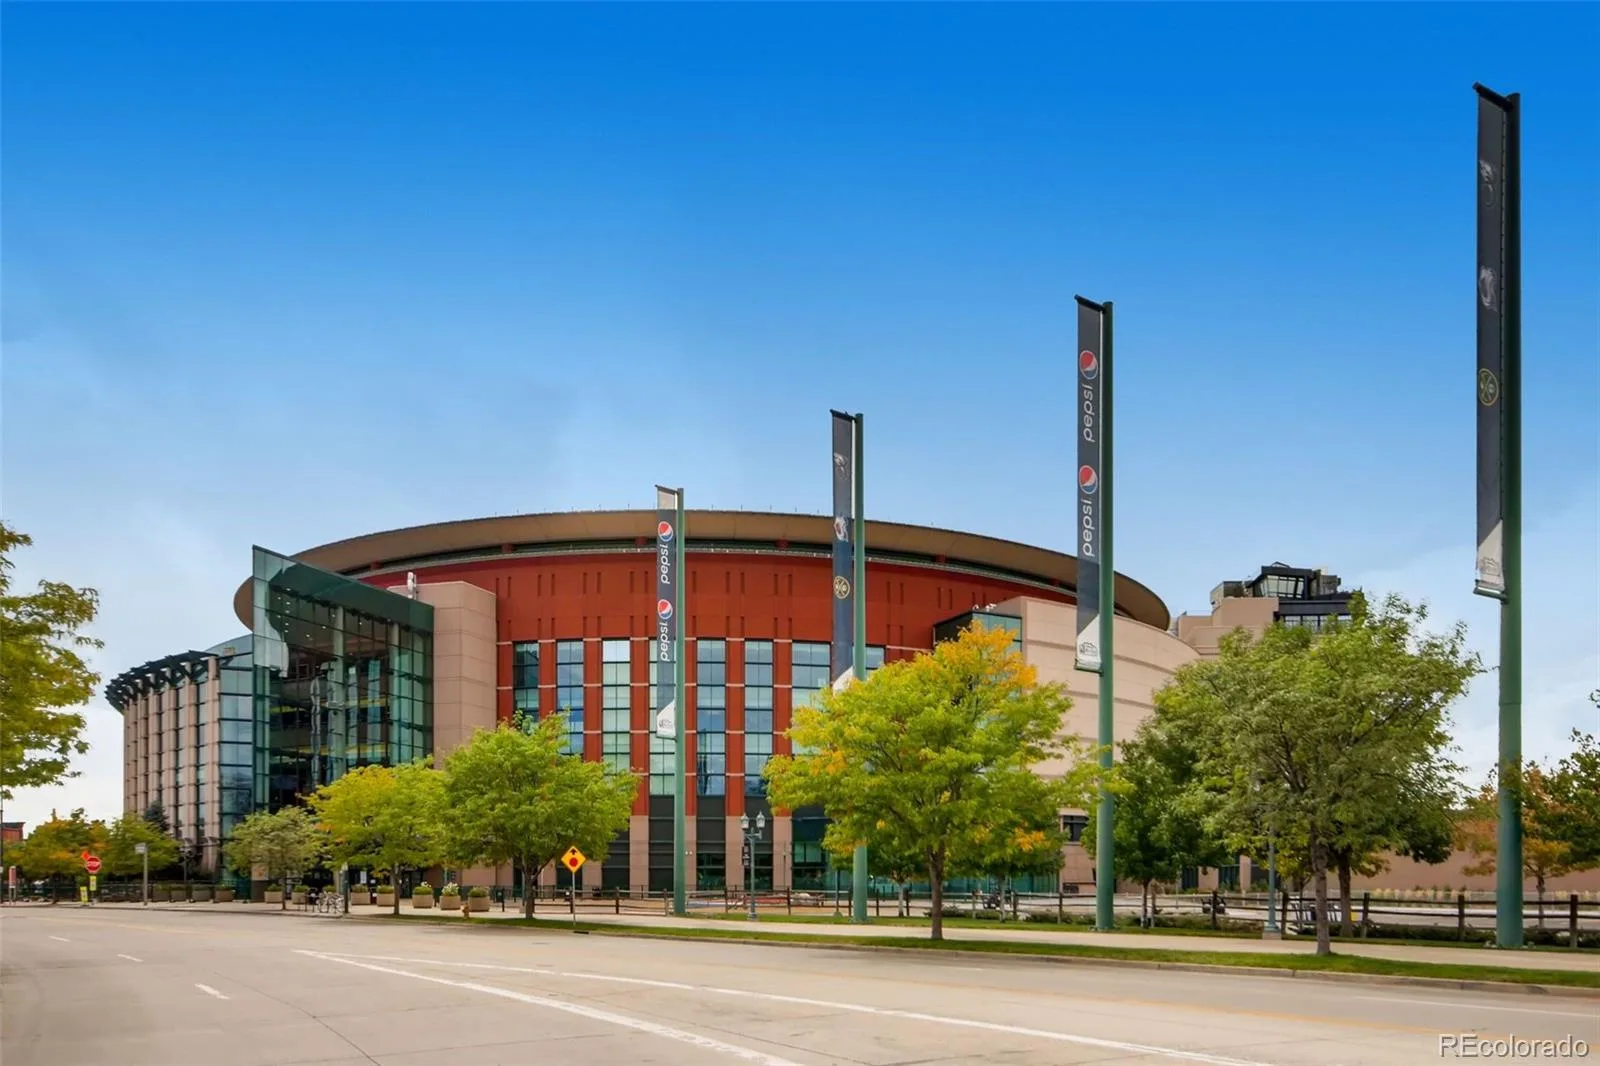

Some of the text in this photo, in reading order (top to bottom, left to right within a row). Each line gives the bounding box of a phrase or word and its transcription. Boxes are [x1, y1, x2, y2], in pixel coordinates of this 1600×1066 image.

[1081, 383, 1095, 443] pepsi
[1081, 498, 1095, 557] pepsi
[659, 544, 671, 584] pepsi
[659, 622, 671, 662] pepsi
